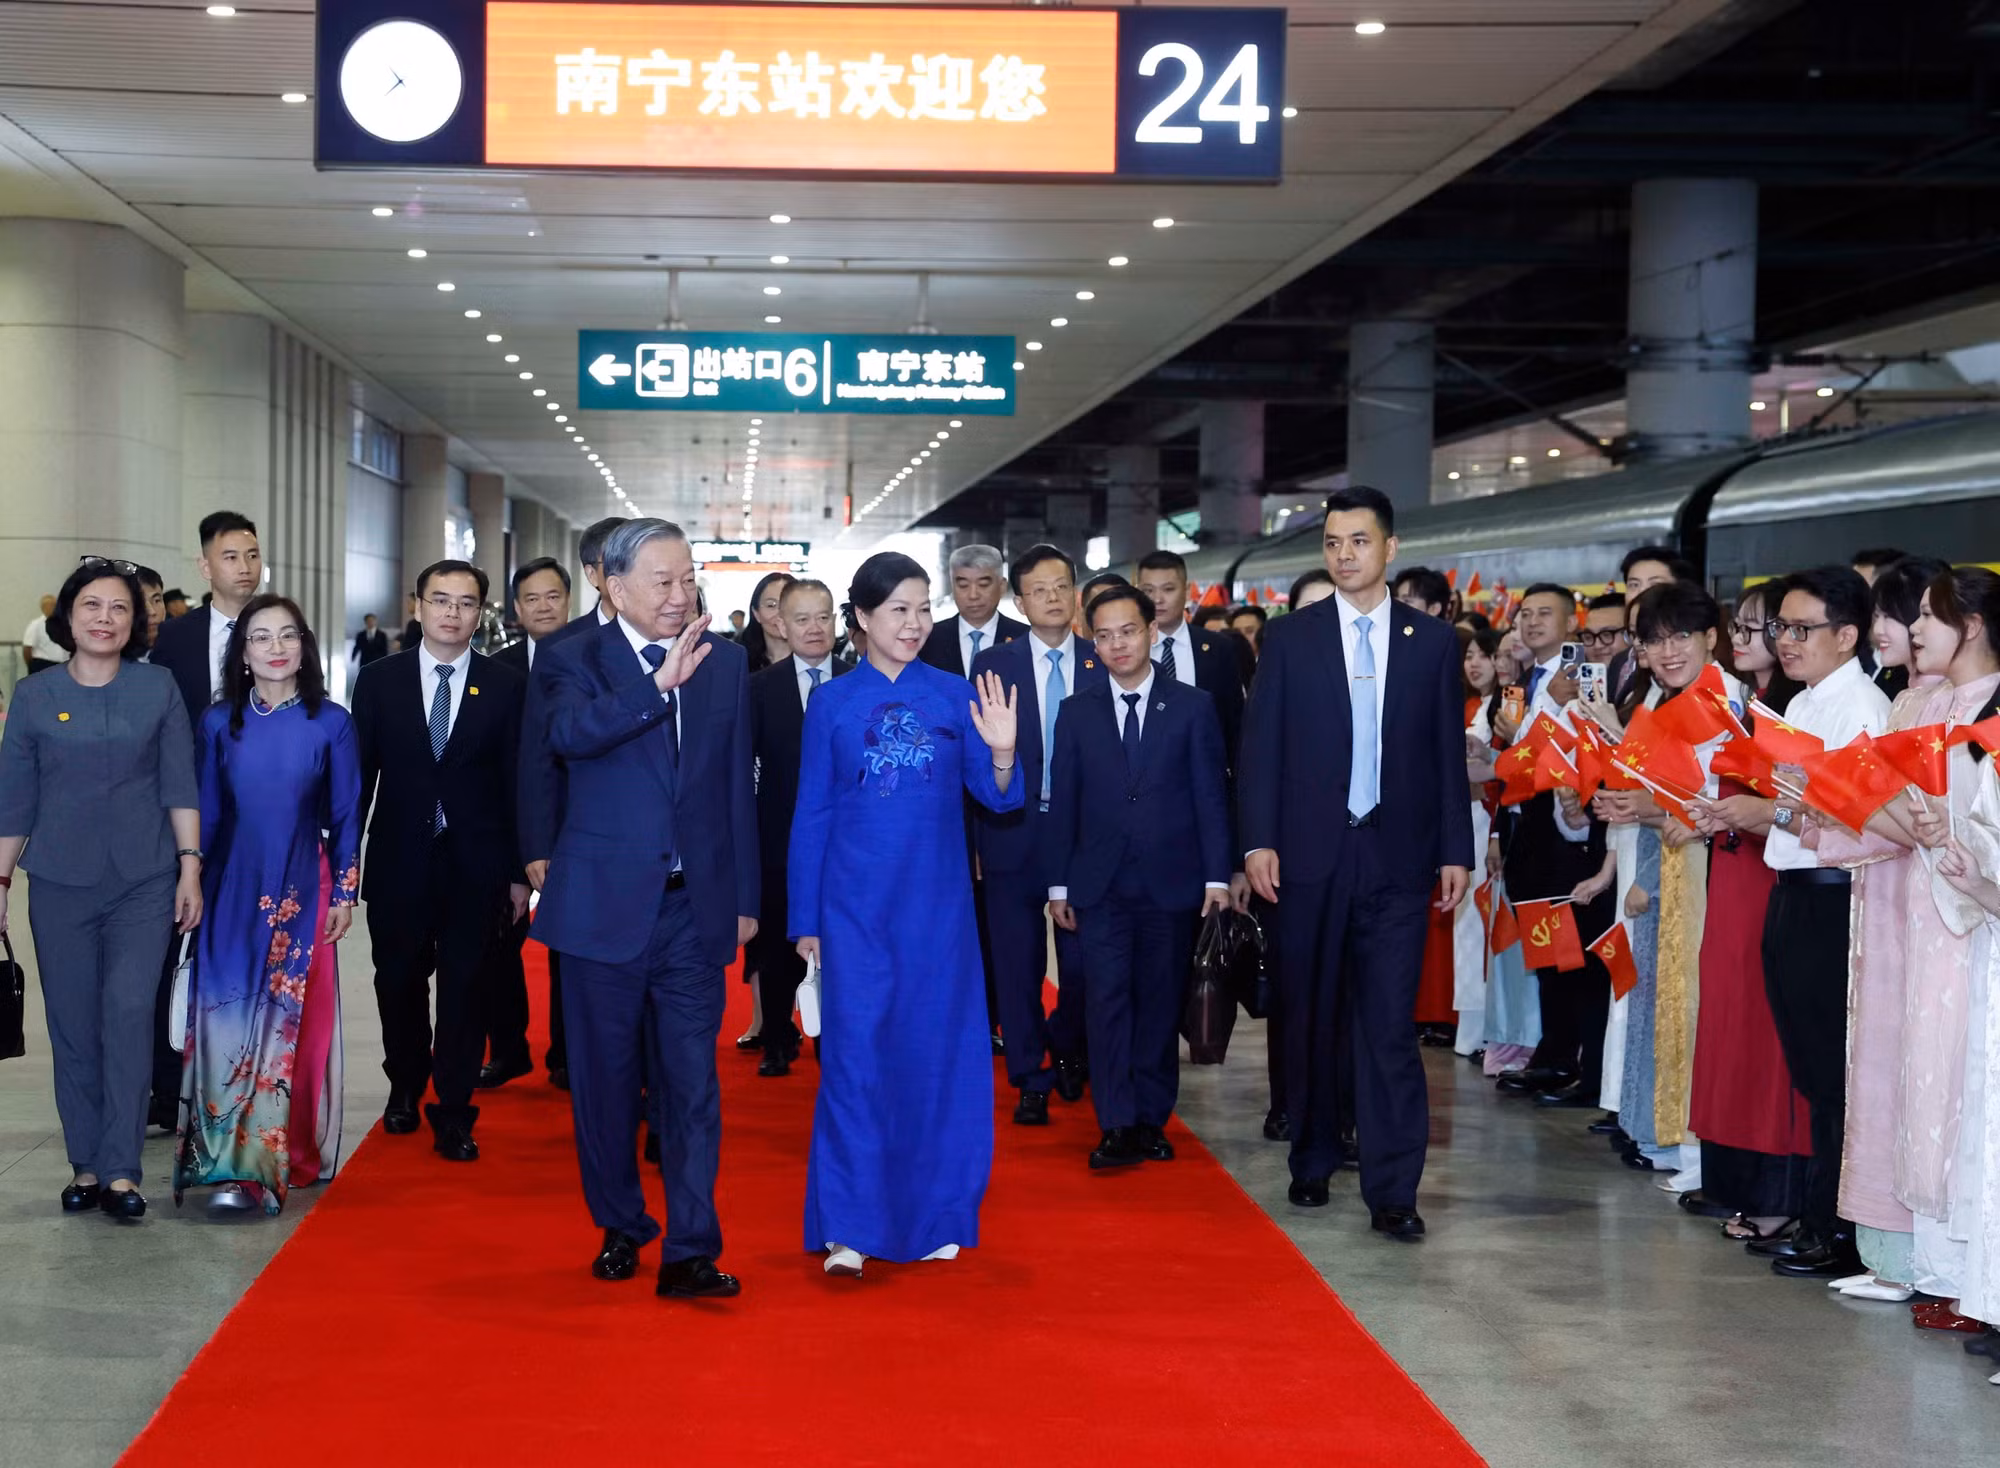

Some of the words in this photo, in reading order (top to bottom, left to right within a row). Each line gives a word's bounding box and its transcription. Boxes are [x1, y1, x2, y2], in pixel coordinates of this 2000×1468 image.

[554, 47, 1048, 123] 南宁东站欢迎您
[1134, 42, 1270, 145] 24
[692, 346, 782, 380] 出站口
[783, 347, 818, 397] 6
[857, 349, 986, 383] 南宁东站
